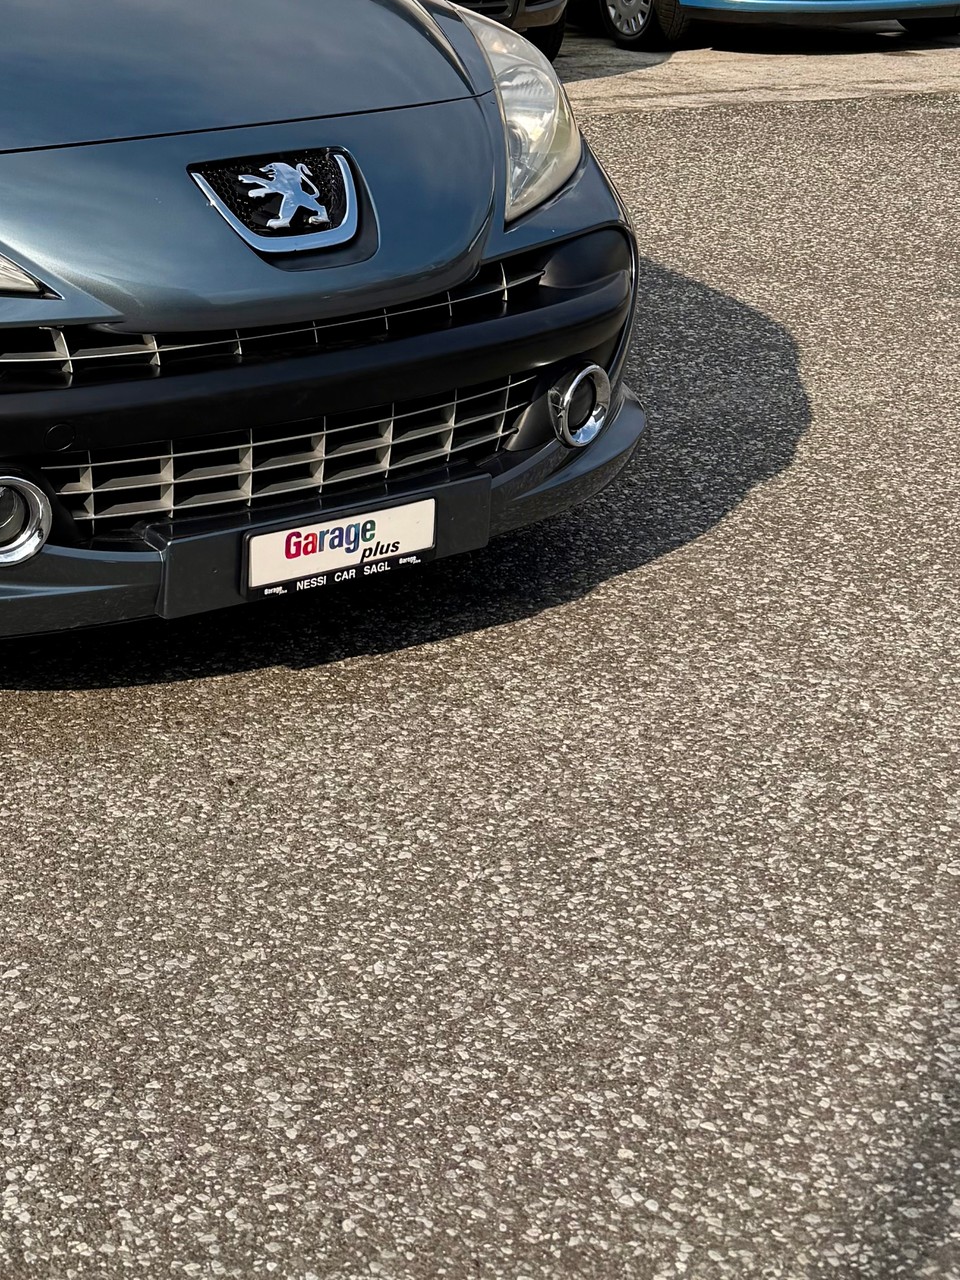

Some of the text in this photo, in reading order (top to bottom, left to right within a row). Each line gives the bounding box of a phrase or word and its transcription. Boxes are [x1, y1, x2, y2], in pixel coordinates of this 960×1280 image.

[284, 519, 377, 560] Garage
[359, 540, 400, 563] plus
[296, 575, 327, 592] NESSI
[334, 568, 357, 582] CAR
[363, 561, 391, 576] SAGL
